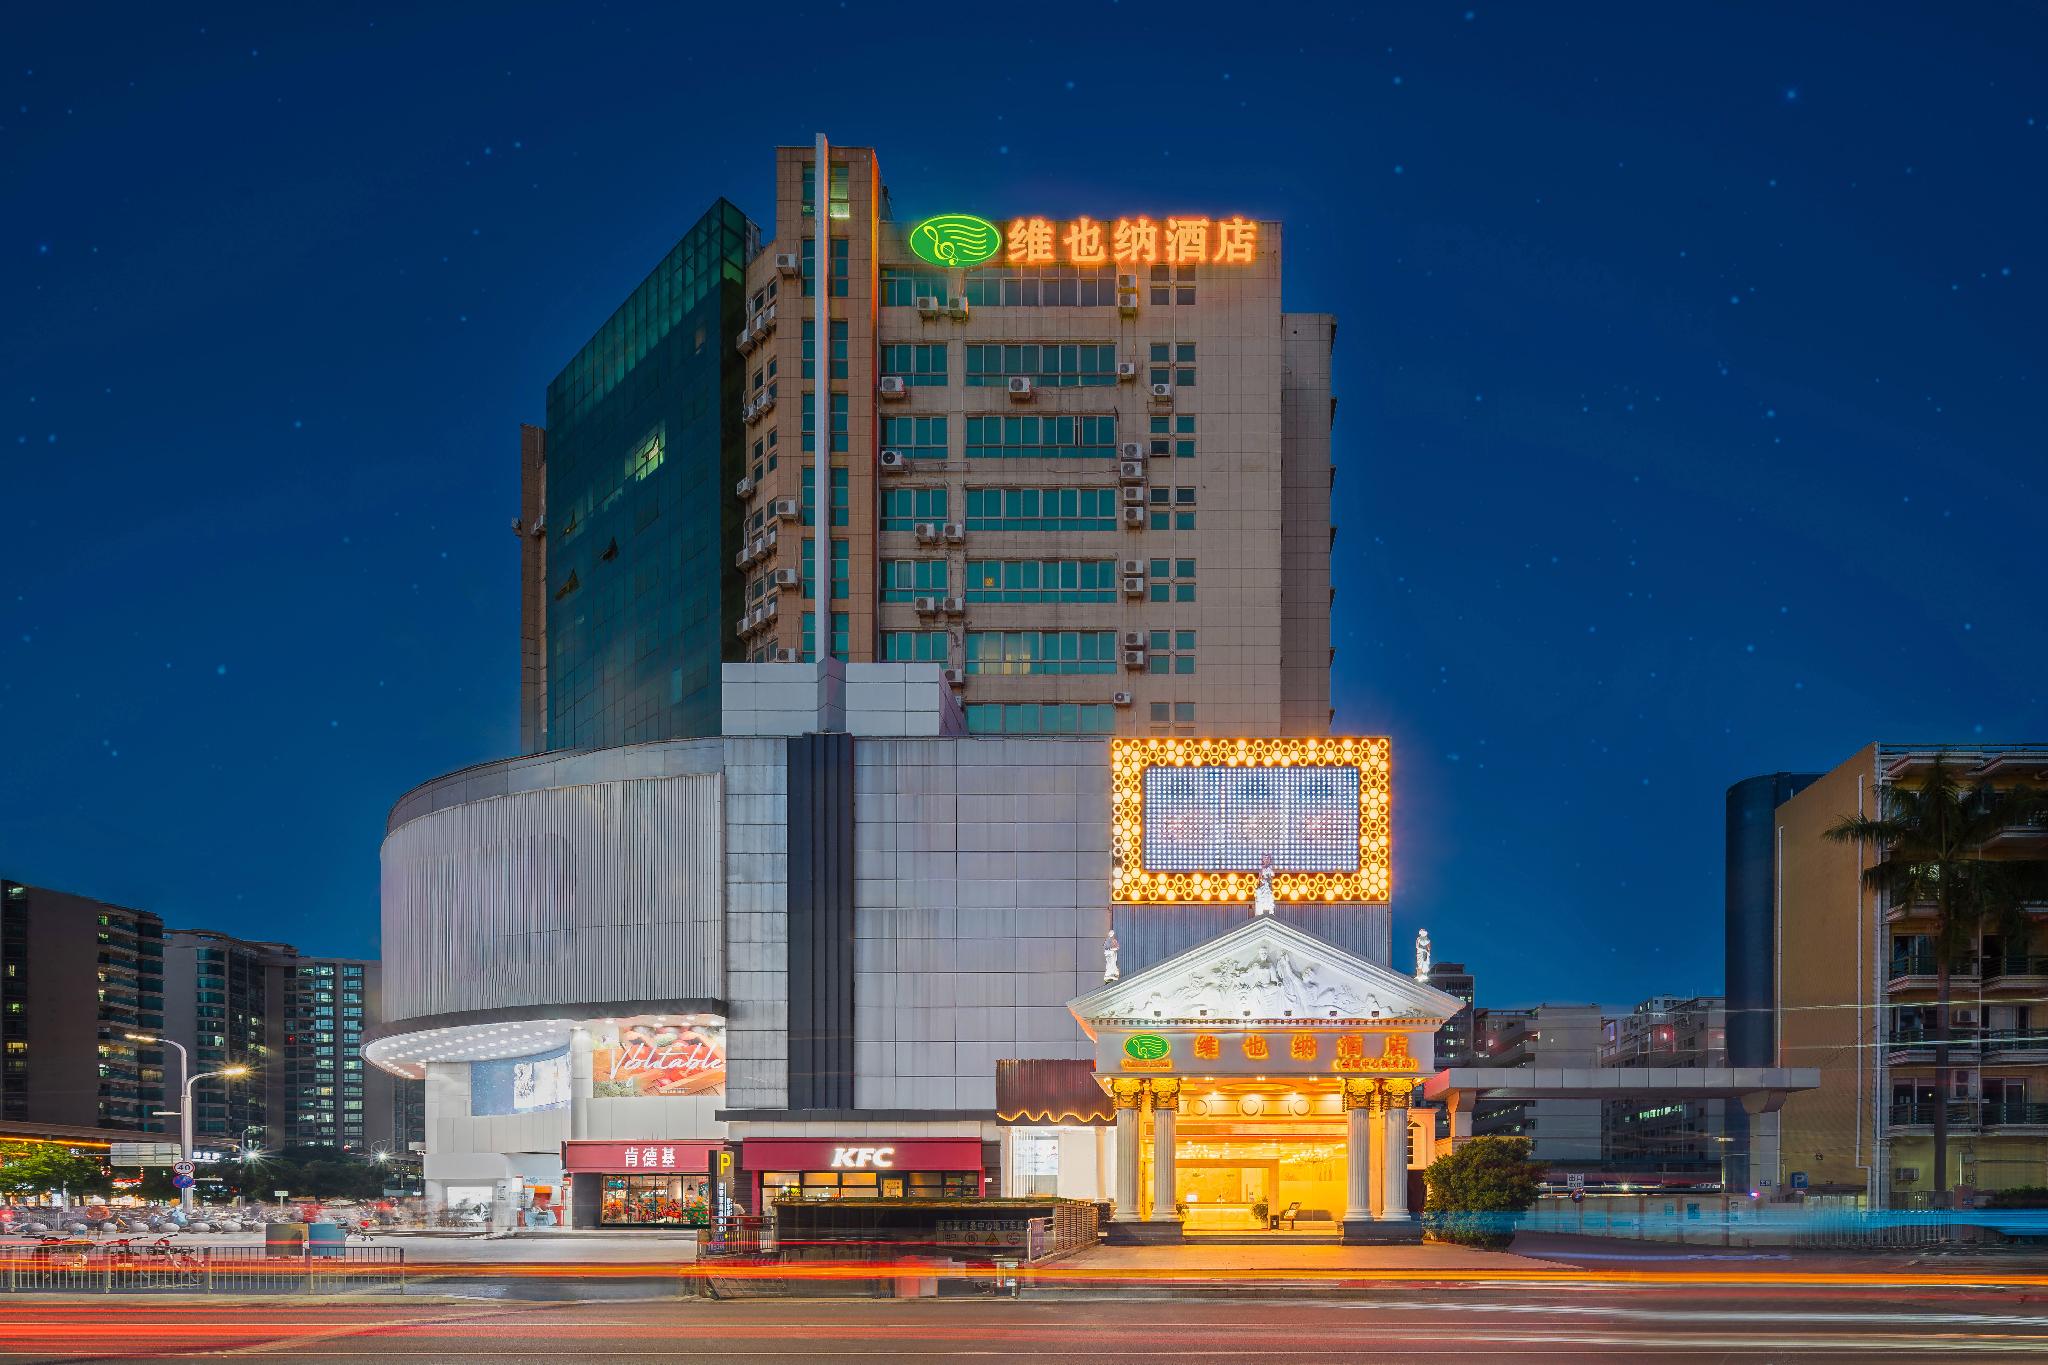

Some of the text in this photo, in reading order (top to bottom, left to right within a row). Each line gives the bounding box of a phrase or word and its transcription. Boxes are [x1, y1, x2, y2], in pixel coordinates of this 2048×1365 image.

[1006, 216, 1258, 263] 维也纳酒店
[1193, 1034, 1409, 1060] 维也纳酒店
[624, 1146, 676, 1168] 肯德基
[720, 1153, 731, 1175] P
[831, 1147, 895, 1168] KFC
[1568, 1174, 1583, 1182] 出口
[1795, 1174, 1805, 1188] P
